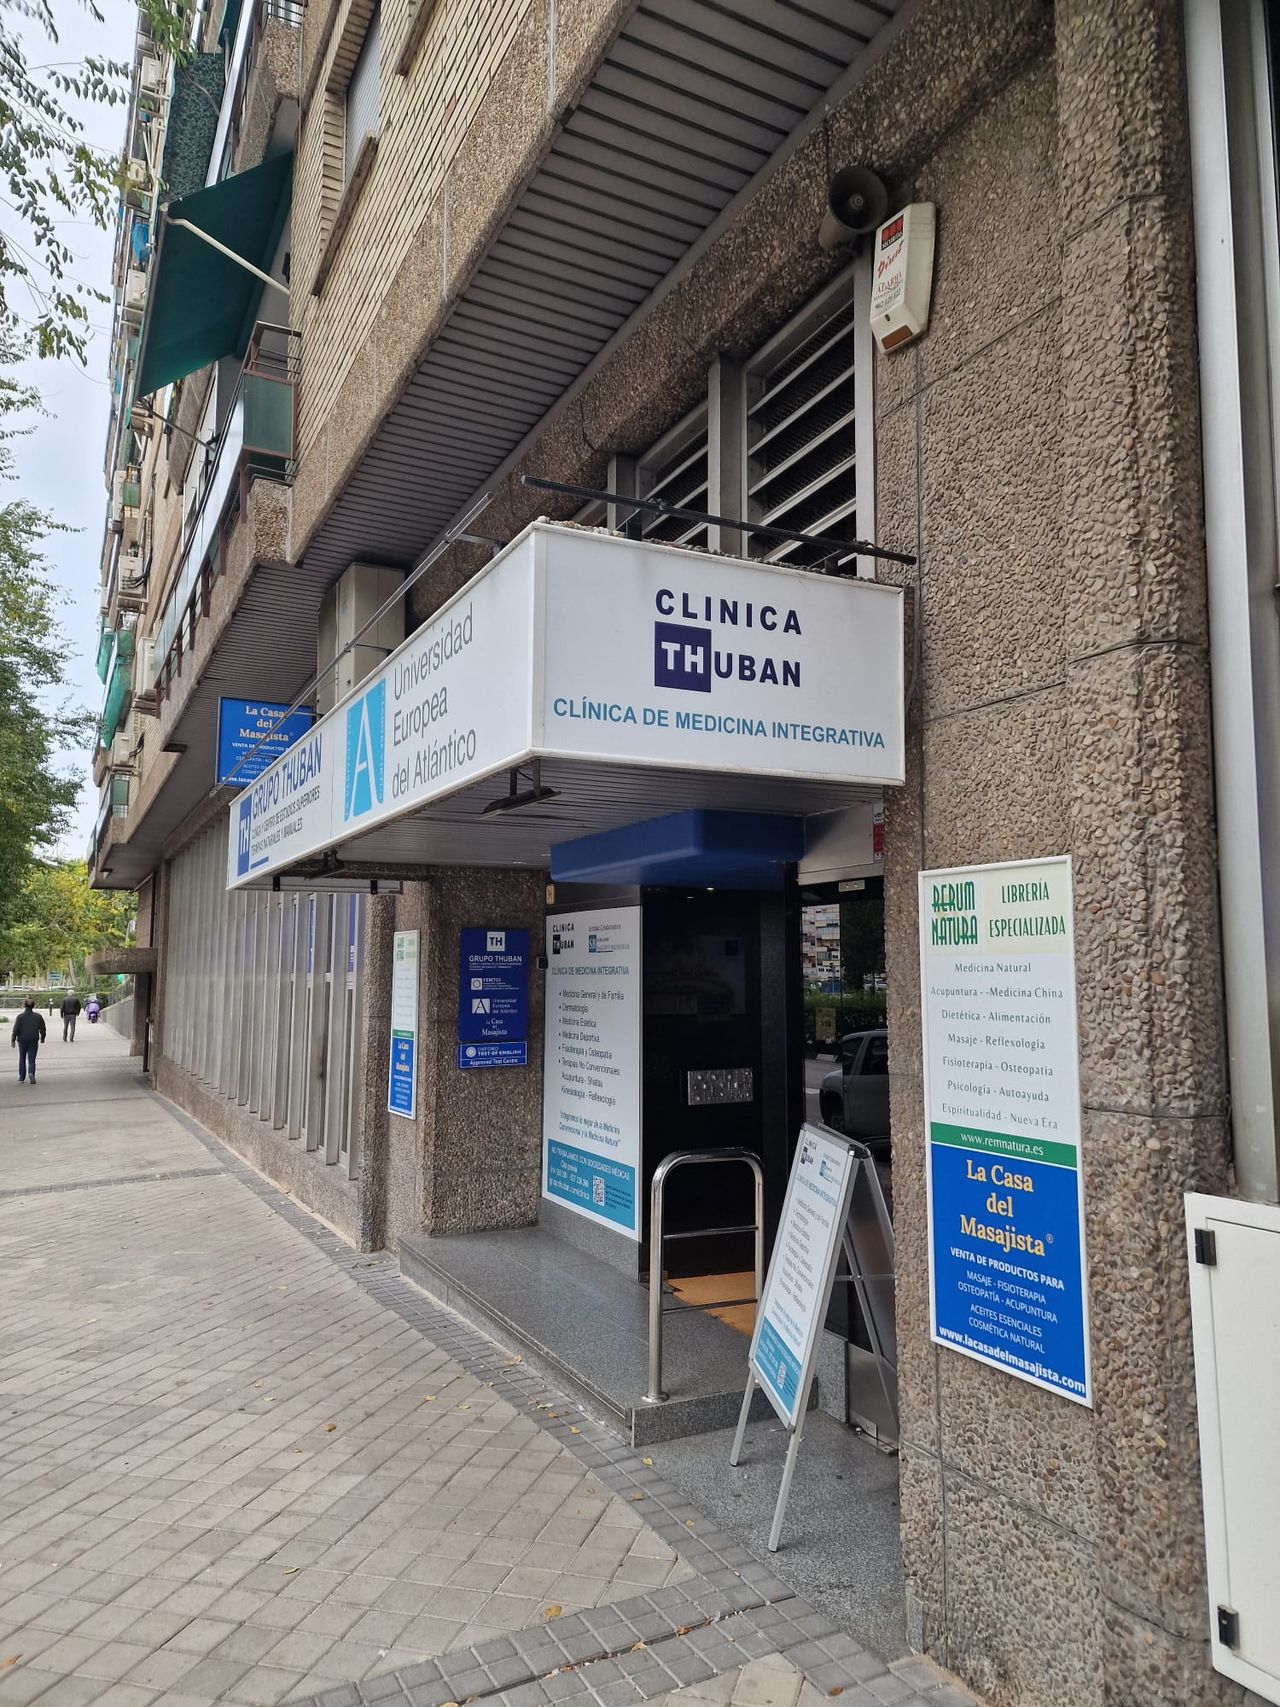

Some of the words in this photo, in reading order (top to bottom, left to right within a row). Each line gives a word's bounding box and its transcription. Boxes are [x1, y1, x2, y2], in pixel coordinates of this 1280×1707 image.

[656, 588, 802, 635] CLINICA
[394, 602, 473, 700] Universidad
[246, 705, 257, 715] La
[260, 708, 286, 718] Casa
[256, 719, 272, 728] del
[393, 686, 448, 747] Europea
[553, 696, 637, 724] CLÍNICA
[643, 708, 668, 727] DE
[676, 712, 767, 738] MEDICINA
[772, 722, 885, 748] INTEGRATIVA
[252, 770, 279, 819] GRUPO
[282, 732, 323, 799] THUBAN
[392, 758, 410, 799] del
[412, 728, 476, 790] Atlántico
[932, 880, 976, 912] RERUM
[1001, 878, 1050, 904] LIBRERÍA
[489, 936, 502, 946] TH
[552, 922, 574, 933] CLINICA
[931, 914, 978, 946] NATURA
[989, 916, 1066, 938] ESPECIALIZADA
[954, 962, 994, 973] Medicina
[997, 962, 1031, 973] Natural
[930, 986, 978, 998] Acupuntura
[1034, 988, 1063, 998] China
[941, 1009, 980, 1022] Dietética
[988, 1010, 1051, 1024] Alimentación
[948, 1033, 978, 1048] Masaje
[986, 1035, 1046, 1050] Reflexología
[942, 1056, 993, 1072] Fisioterapia
[947, 1080, 991, 1095] Psicología
[1000, 1086, 1050, 1102] Autoayuda
[942, 1104, 1002, 1121] Espiritualidad
[1010, 1113, 1040, 1128] Nueva
[1042, 1118, 1058, 1130] Era
[960, 1132, 1044, 1156] www.remnatura.es
[966, 1160, 986, 1182] La
[990, 1166, 1034, 1192] Casa
[986, 1192, 1014, 1218] del
[950, 1246, 976, 1264] VENTA
[976, 1254, 988, 1266] DE
[988, 1258, 1040, 1283] PRODUCTOS
[1040, 1274, 1065, 1290] PARA
[958, 1281, 1000, 1304] OSTEOPATÍA
[1005, 1298, 1058, 1324] ACUPUNTURA
[966, 1270, 993, 1288] MASAJE
[997, 1280, 1046, 1304] FISIOTERAPIA
[968, 1316, 1008, 1338] COSMÉTICA
[1010, 1332, 1046, 1354] NATURAL
[970, 1303, 998, 1320] ACEITES
[999, 1314, 1042, 1338] ESENCIALES
[939, 1325, 1086, 1394] www.lacasadelmasajista.com
